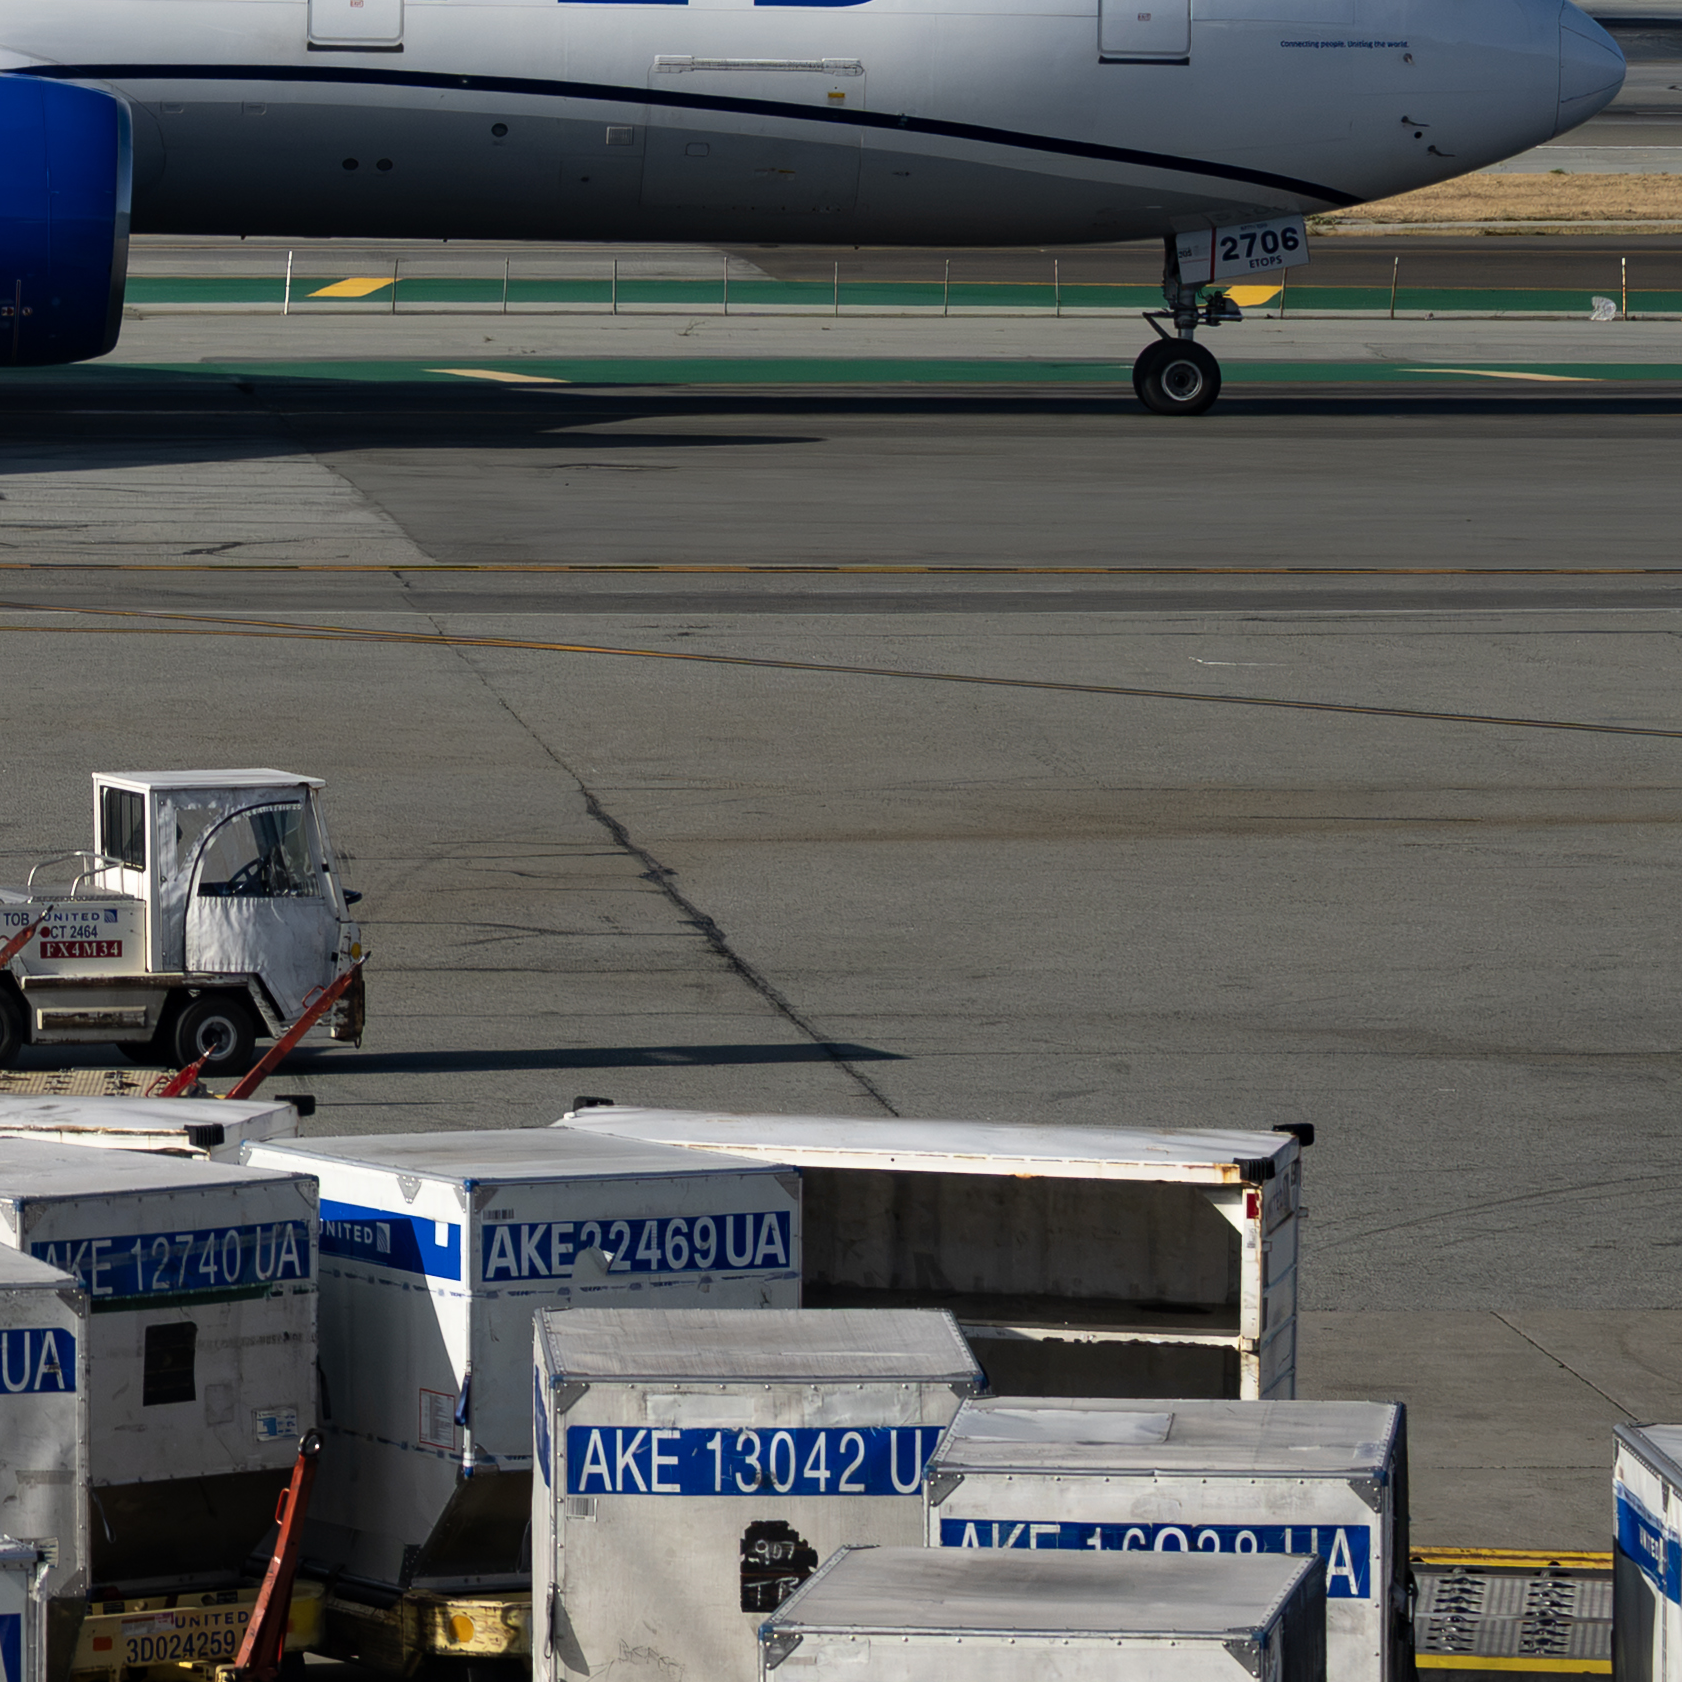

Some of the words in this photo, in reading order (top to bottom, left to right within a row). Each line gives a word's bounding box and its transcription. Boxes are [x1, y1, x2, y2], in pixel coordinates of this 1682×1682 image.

[1374, 40, 1386, 48] the
[1220, 226, 1299, 261] 2706
[1249, 255, 1283, 269] ETOPS
[4, 913, 30, 926] TOB
[43, 912, 100, 922] UNITED
[50, 926, 67, 939] CT
[70, 925, 98, 939] 2464
[46, 942, 119, 957] FX4M34
[485, 1223, 574, 1279] AKE
[726, 1213, 787, 1267] UA
[131, 1229, 241, 1292] 12740
[255, 1222, 303, 1281] UA
[1, 1329, 65, 1392] UA
[578, 1429, 681, 1493] AKE
[706, 1430, 866, 1493] 13042
[891, 1428, 945, 1494] U
[174, 1611, 249, 1629] UNITED
[126, 1629, 236, 1664] 3D024259
